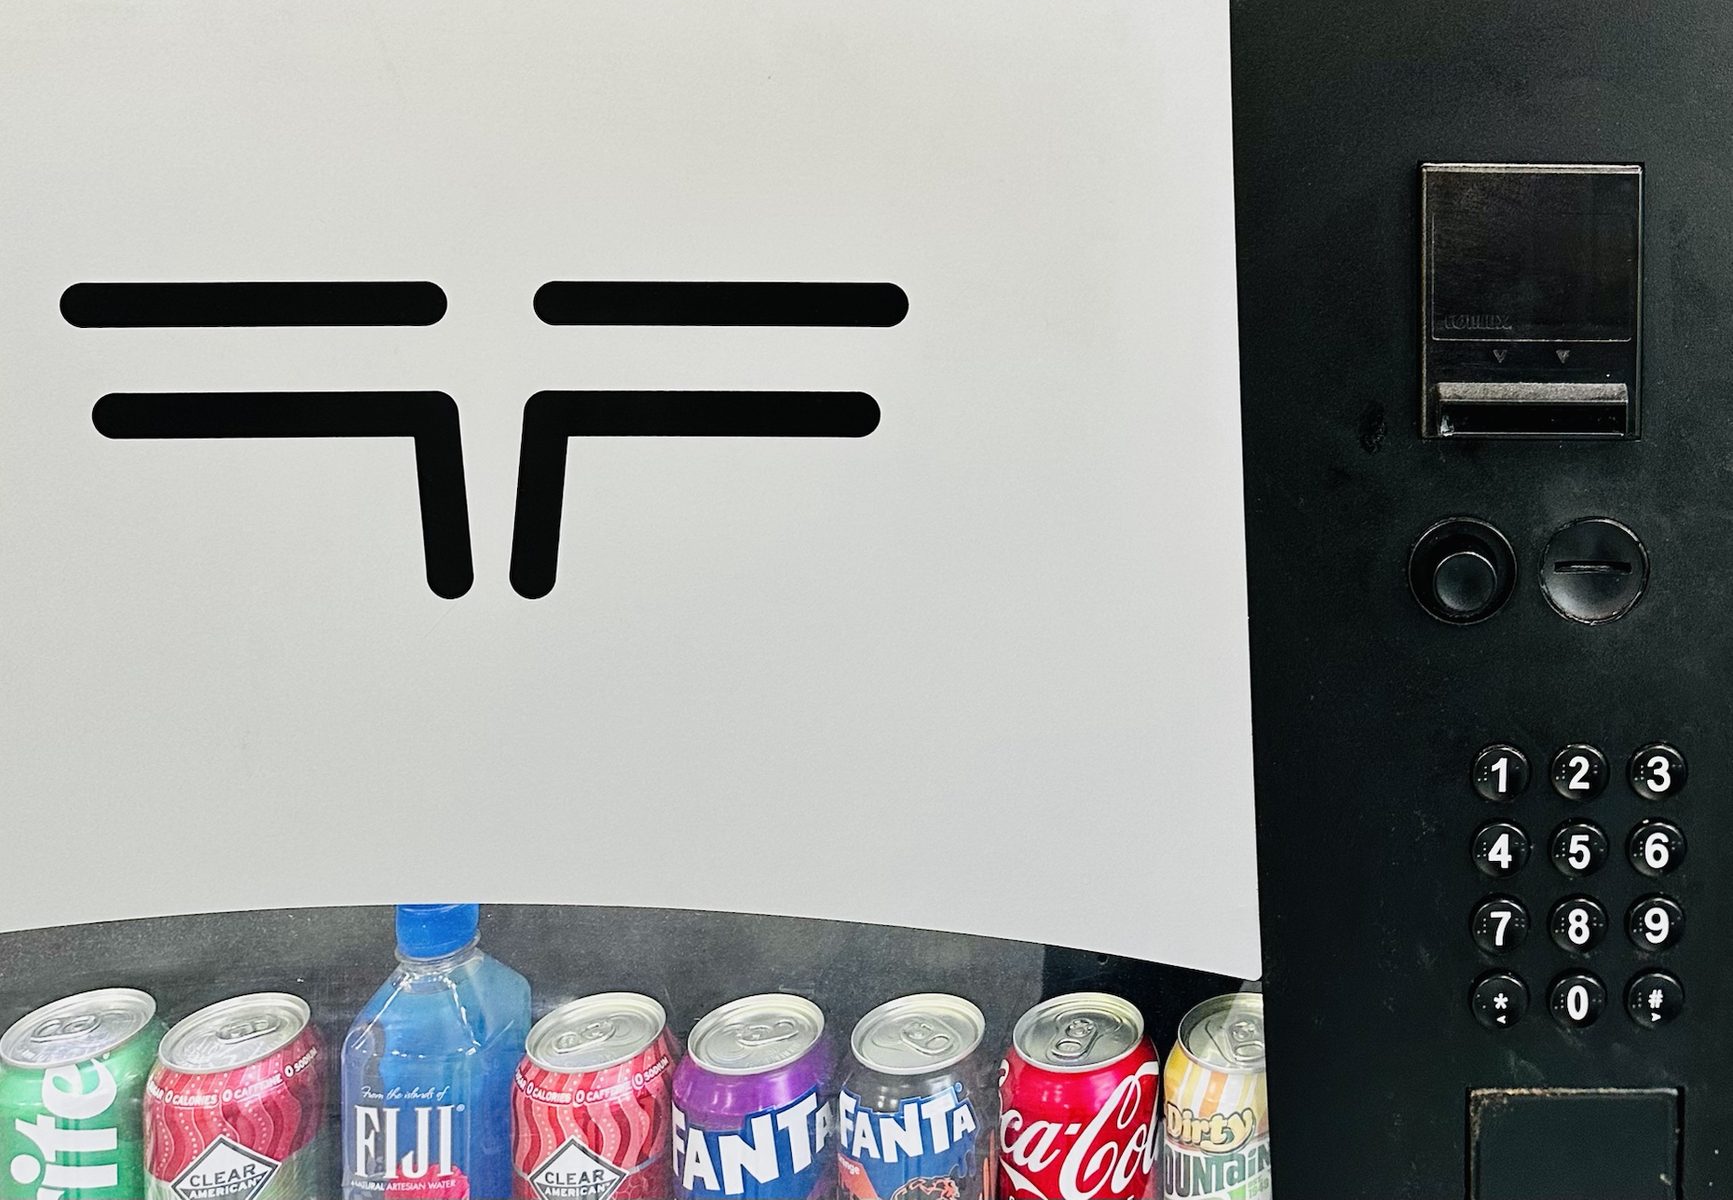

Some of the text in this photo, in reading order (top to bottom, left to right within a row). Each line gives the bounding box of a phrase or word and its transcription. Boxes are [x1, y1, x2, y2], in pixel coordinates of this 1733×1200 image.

[1491, 755, 1671, 793] 1 2 3
[1487, 832, 1670, 870] 4 5 6
[1490, 907, 1670, 946] 7 8 9
[1566, 985, 1589, 1022] 0
[1648, 989, 1664, 1009] #
[164, 1089, 173, 1104] 0
[173, 1094, 218, 1106] CALORIES
[222, 1088, 233, 1102] 0
[234, 1073, 283, 1100] CAFFEINE
[284, 1063, 294, 1078] 0
[294, 1047, 318, 1073] SODIUM
[361, 1085, 450, 1101] From the islands of
[526, 1057, 670, 1104] 0 CALORIES 0 CAFFEINE 0 SODIUM
[10, 1058, 118, 1200] ite
[354, 1104, 456, 1179] FIJI
[672, 1091, 831, 1196] FANTA
[839, 1089, 976, 1163] FANTA
[1000, 1060, 1160, 1200] ca-Col
[1166, 1101, 1256, 1155] Dirty
[188, 1174, 261, 1200] AMERICAN
[189, 1163, 256, 1187] CLEAR
[386, 1181, 426, 1191] ARTESIAN
[427, 1180, 456, 1190] WATER
[544, 1169, 604, 1185] CLEAR
[544, 1183, 608, 1197] AMERICAN
